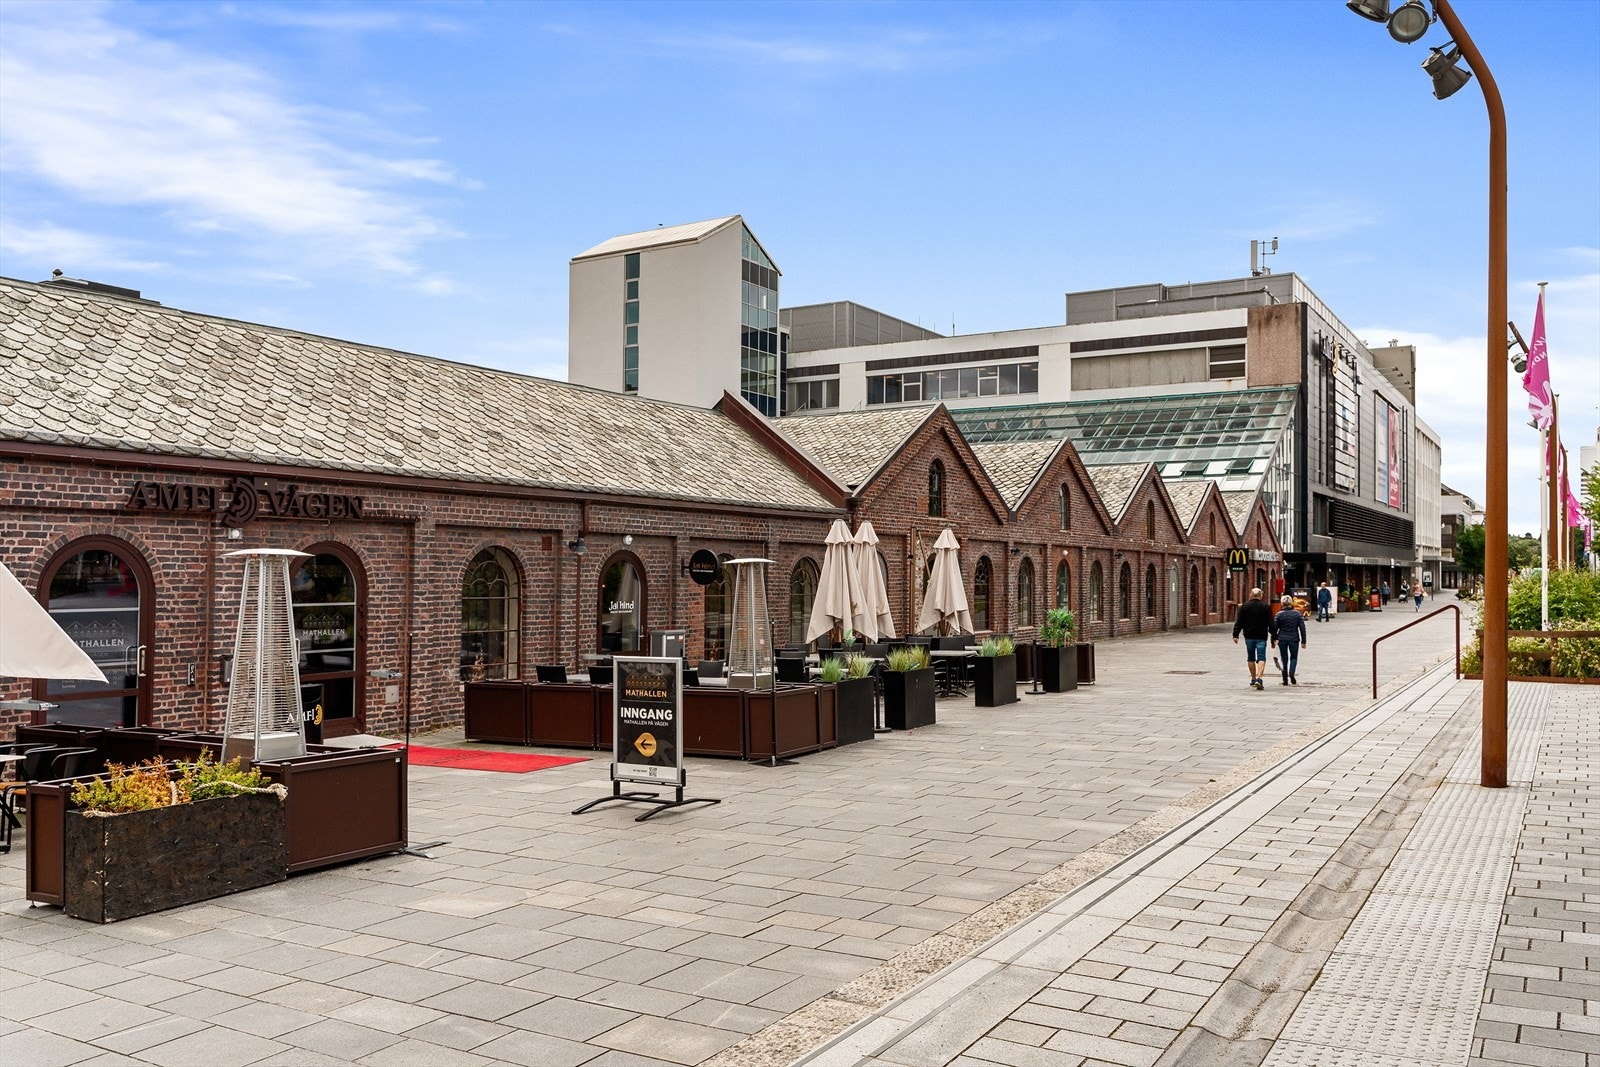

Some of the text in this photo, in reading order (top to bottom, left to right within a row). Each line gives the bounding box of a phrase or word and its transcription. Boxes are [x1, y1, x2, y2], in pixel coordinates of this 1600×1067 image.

[127, 480, 221, 512] AMFI
[266, 485, 365, 520] VÅGEN
[608, 600, 634, 611] Jai hind
[302, 628, 345, 637] MATHALLEN
[74, 638, 125, 649] ATHALLEN
[625, 689, 667, 698] MATHALLEN
[620, 706, 673, 721] INNGANG
